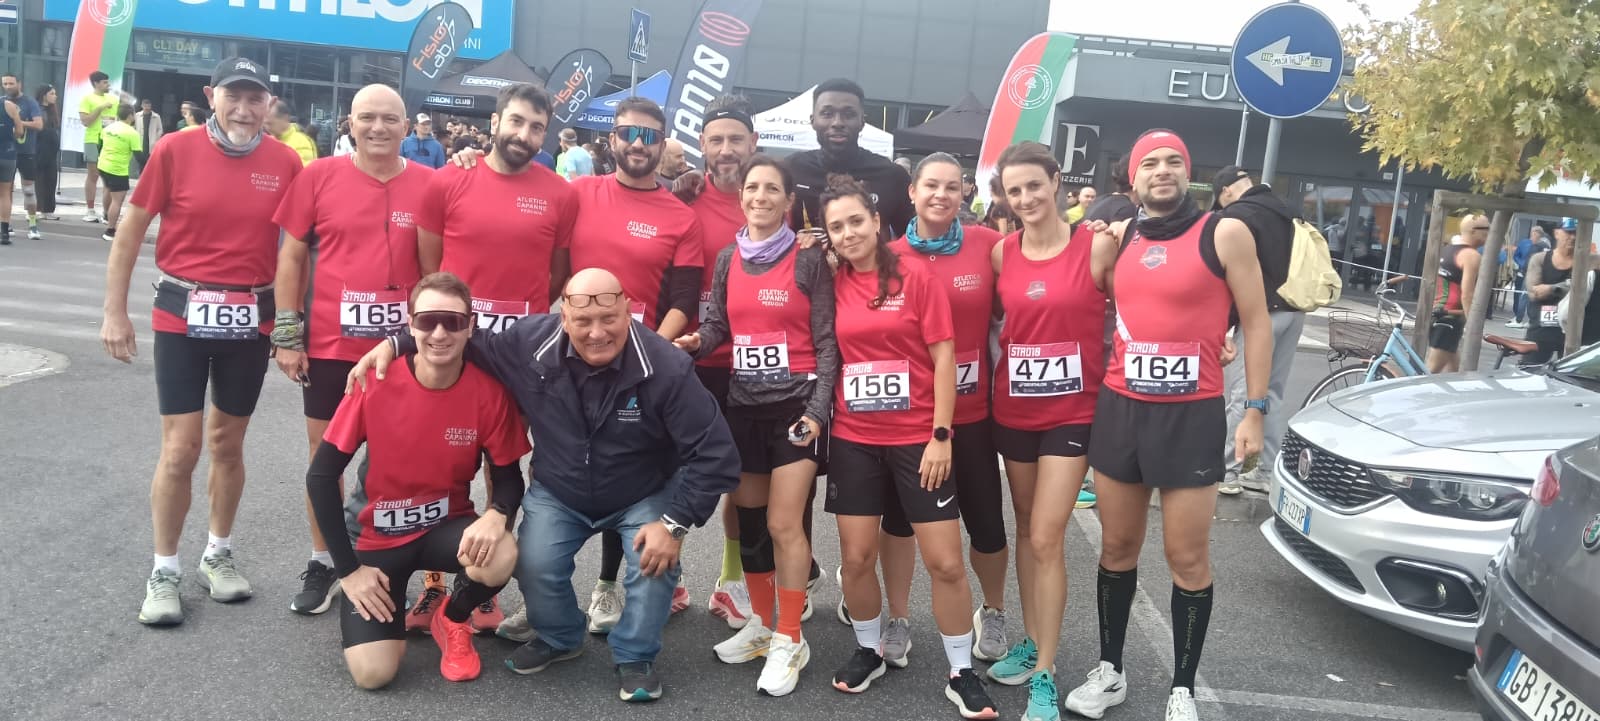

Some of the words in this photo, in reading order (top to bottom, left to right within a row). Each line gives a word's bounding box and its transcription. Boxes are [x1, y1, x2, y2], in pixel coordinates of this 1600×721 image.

[422, 43, 452, 79] Lab
[553, 89, 588, 123] Lab
[759, 132, 794, 142] CATHLON
[1061, 175, 1093, 184] IZZERIE
[757, 294, 788, 303] CAPANNE
[758, 289, 789, 297] ATLETICA
[197, 304, 251, 326] 163
[348, 303, 402, 325] 165
[736, 346, 780, 369] 158
[1015, 357, 1069, 380] 471
[1131, 355, 1191, 380] 164
[849, 374, 901, 398] 156
[382, 501, 441, 527] 155
[1510, 661, 1538, 703] GB
[1534, 681, 1600, 721] 138
